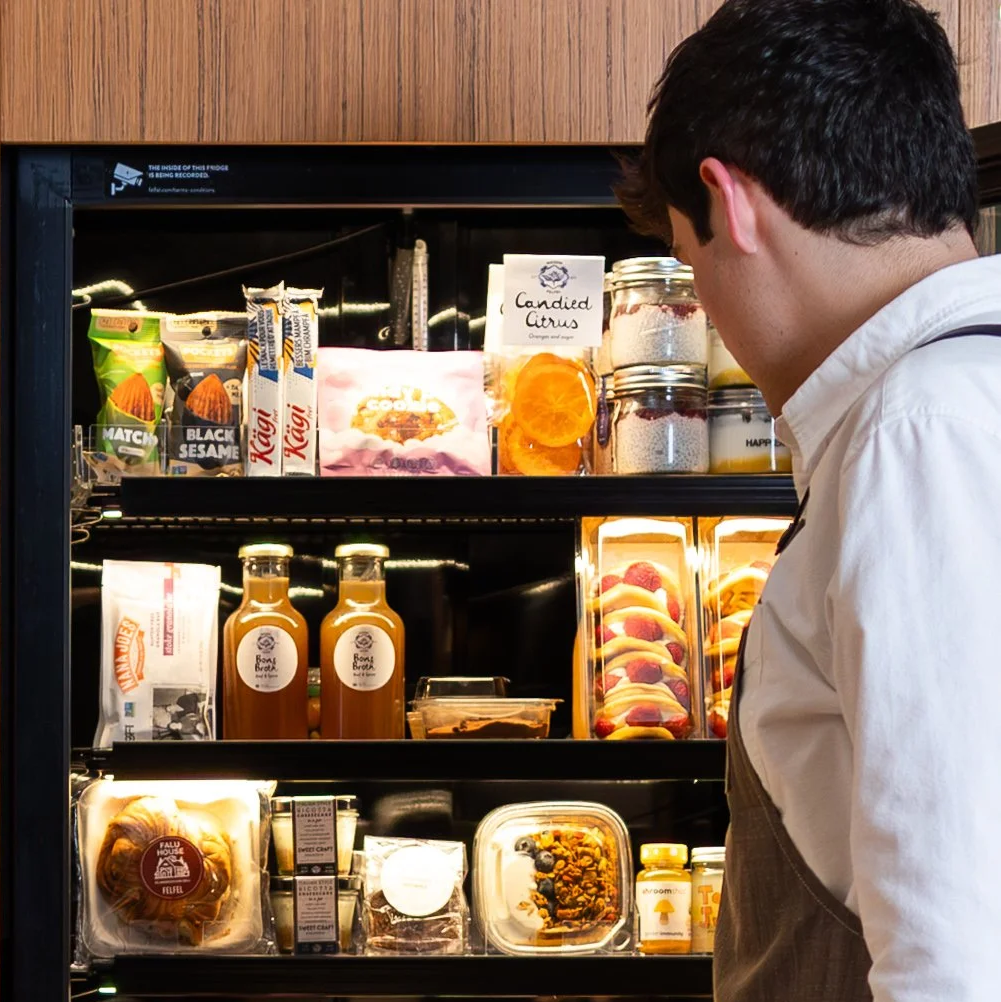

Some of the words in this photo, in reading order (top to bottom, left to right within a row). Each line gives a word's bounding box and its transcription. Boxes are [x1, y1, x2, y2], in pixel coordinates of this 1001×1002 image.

[515, 291, 593, 311] Candied
[525, 310, 579, 329] Citrus
[186, 428, 235, 443] BLACK
[250, 407, 276, 466] Kägi
[284, 403, 310, 460] Kägi
[179, 443, 240, 459] SESAME
[162, 885, 184, 895] FELFEL
